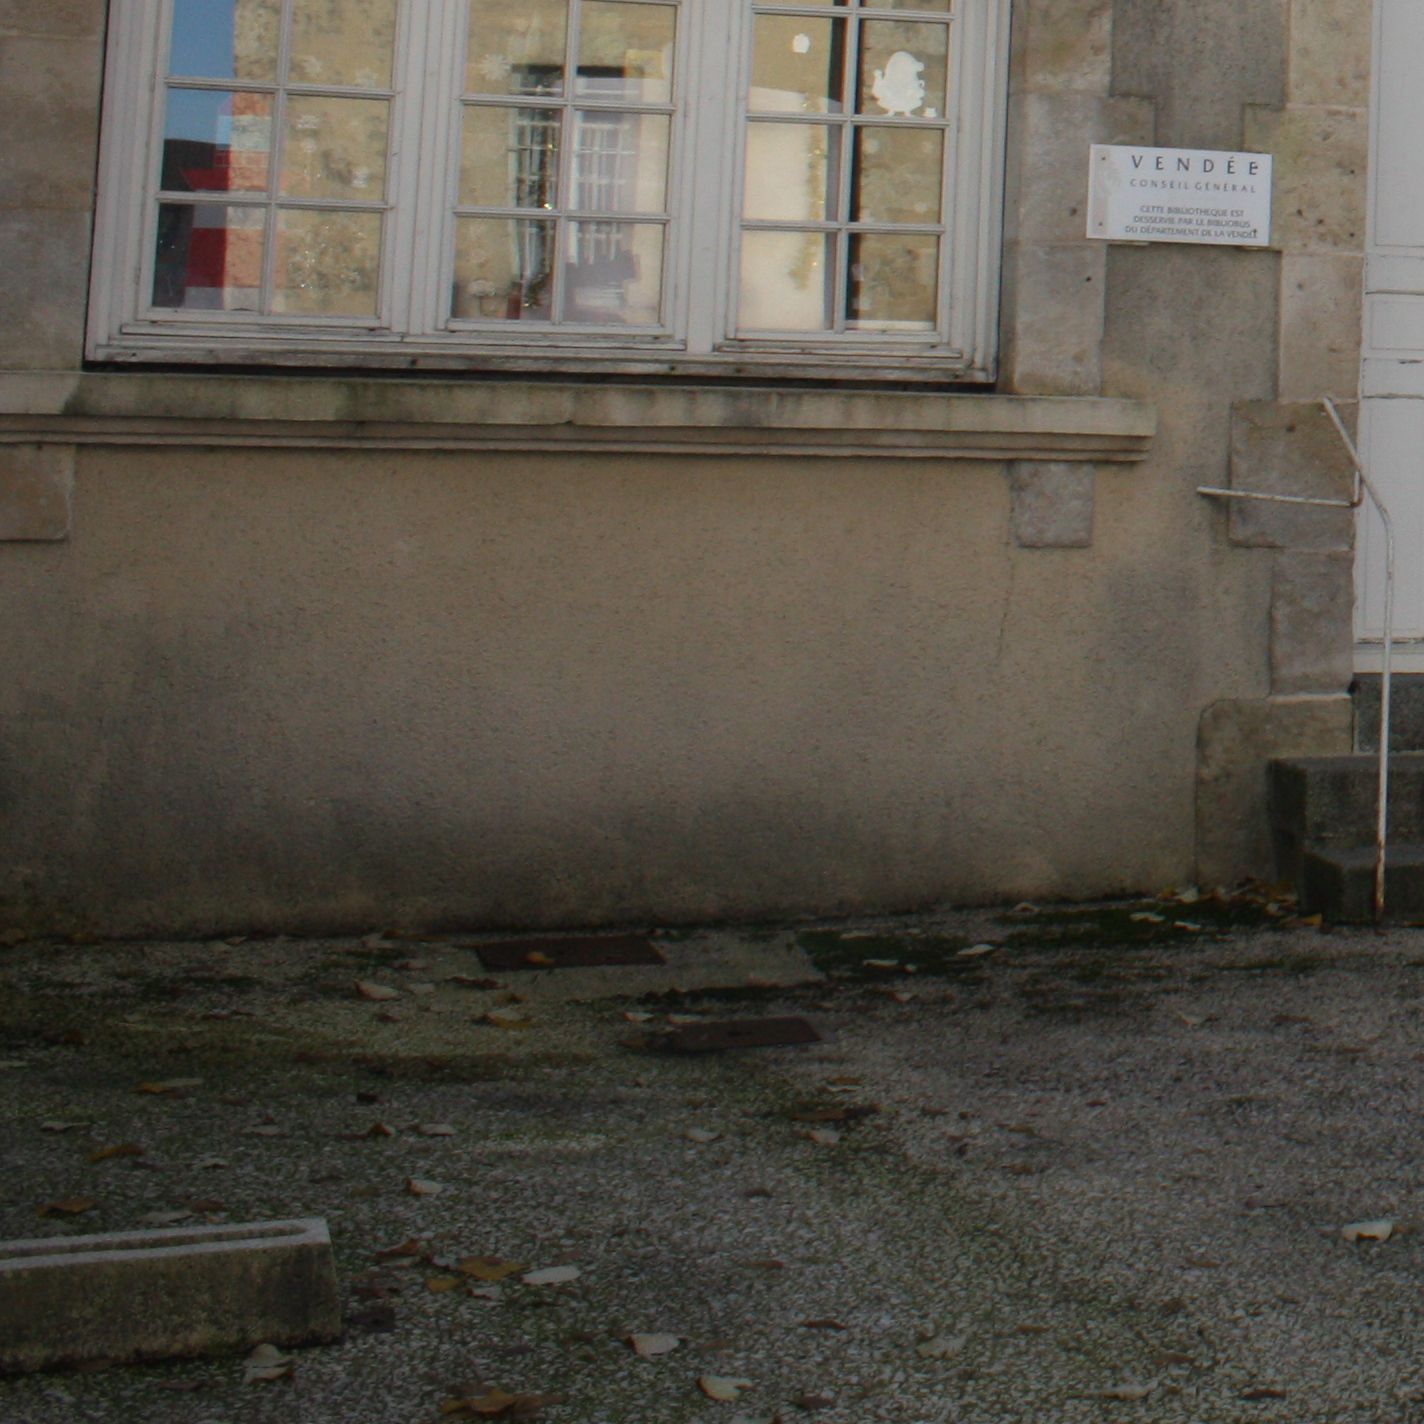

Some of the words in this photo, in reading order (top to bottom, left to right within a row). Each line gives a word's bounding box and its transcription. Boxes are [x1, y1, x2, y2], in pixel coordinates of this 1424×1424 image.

[1131, 155, 1258, 176] VENDÉE
[1130, 178, 1189, 191] CONSEIL
[1230, 209, 1245, 217] EST
[1178, 217, 1193, 226] PAR
